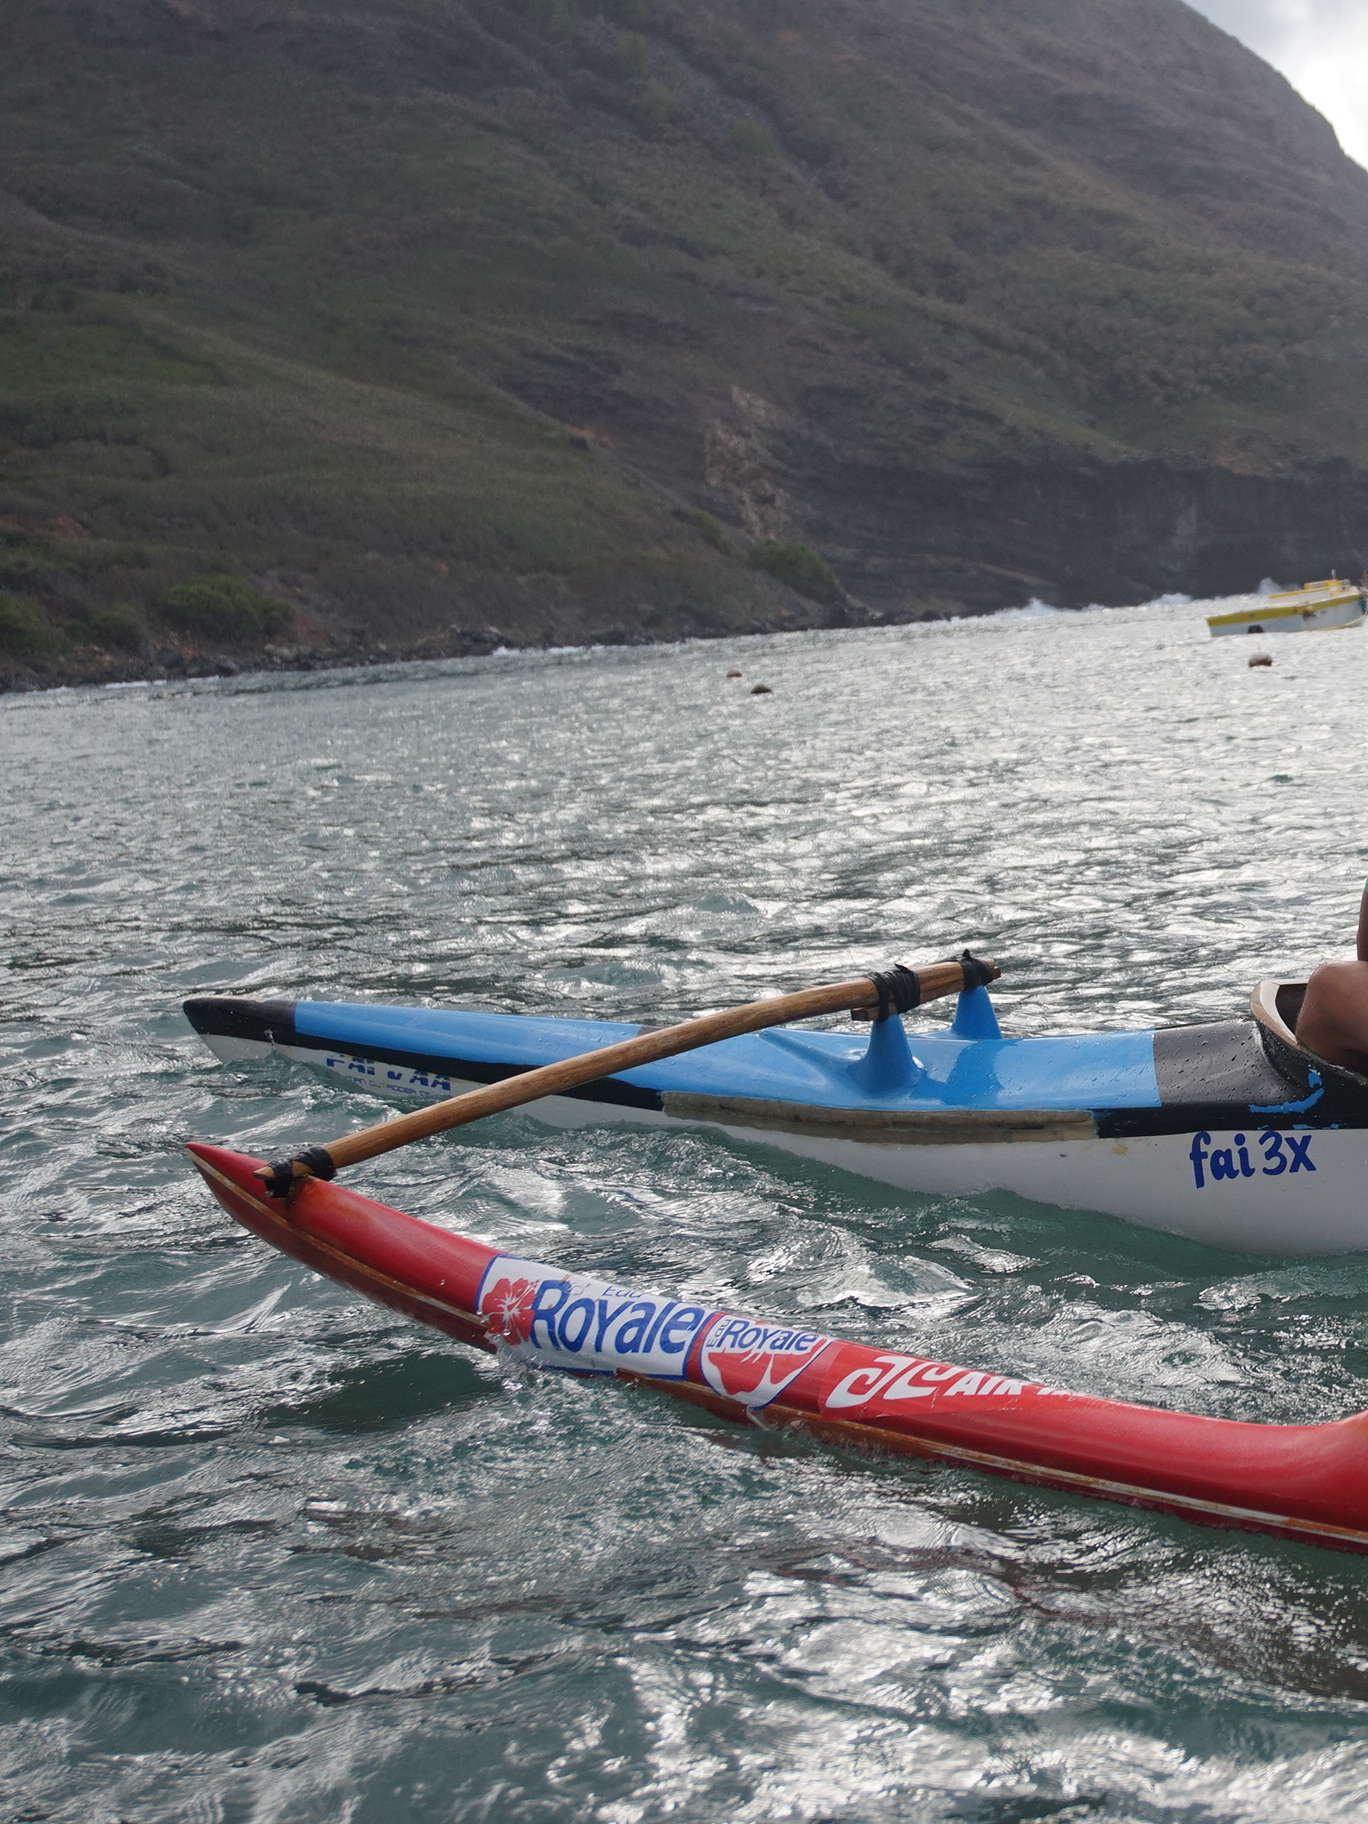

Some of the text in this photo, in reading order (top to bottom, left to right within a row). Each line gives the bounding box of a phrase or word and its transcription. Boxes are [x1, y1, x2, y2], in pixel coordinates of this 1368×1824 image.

[1189, 1130, 1256, 1189] fai
[530, 1279, 706, 1354] Royale
[717, 1319, 820, 1351] Royale
